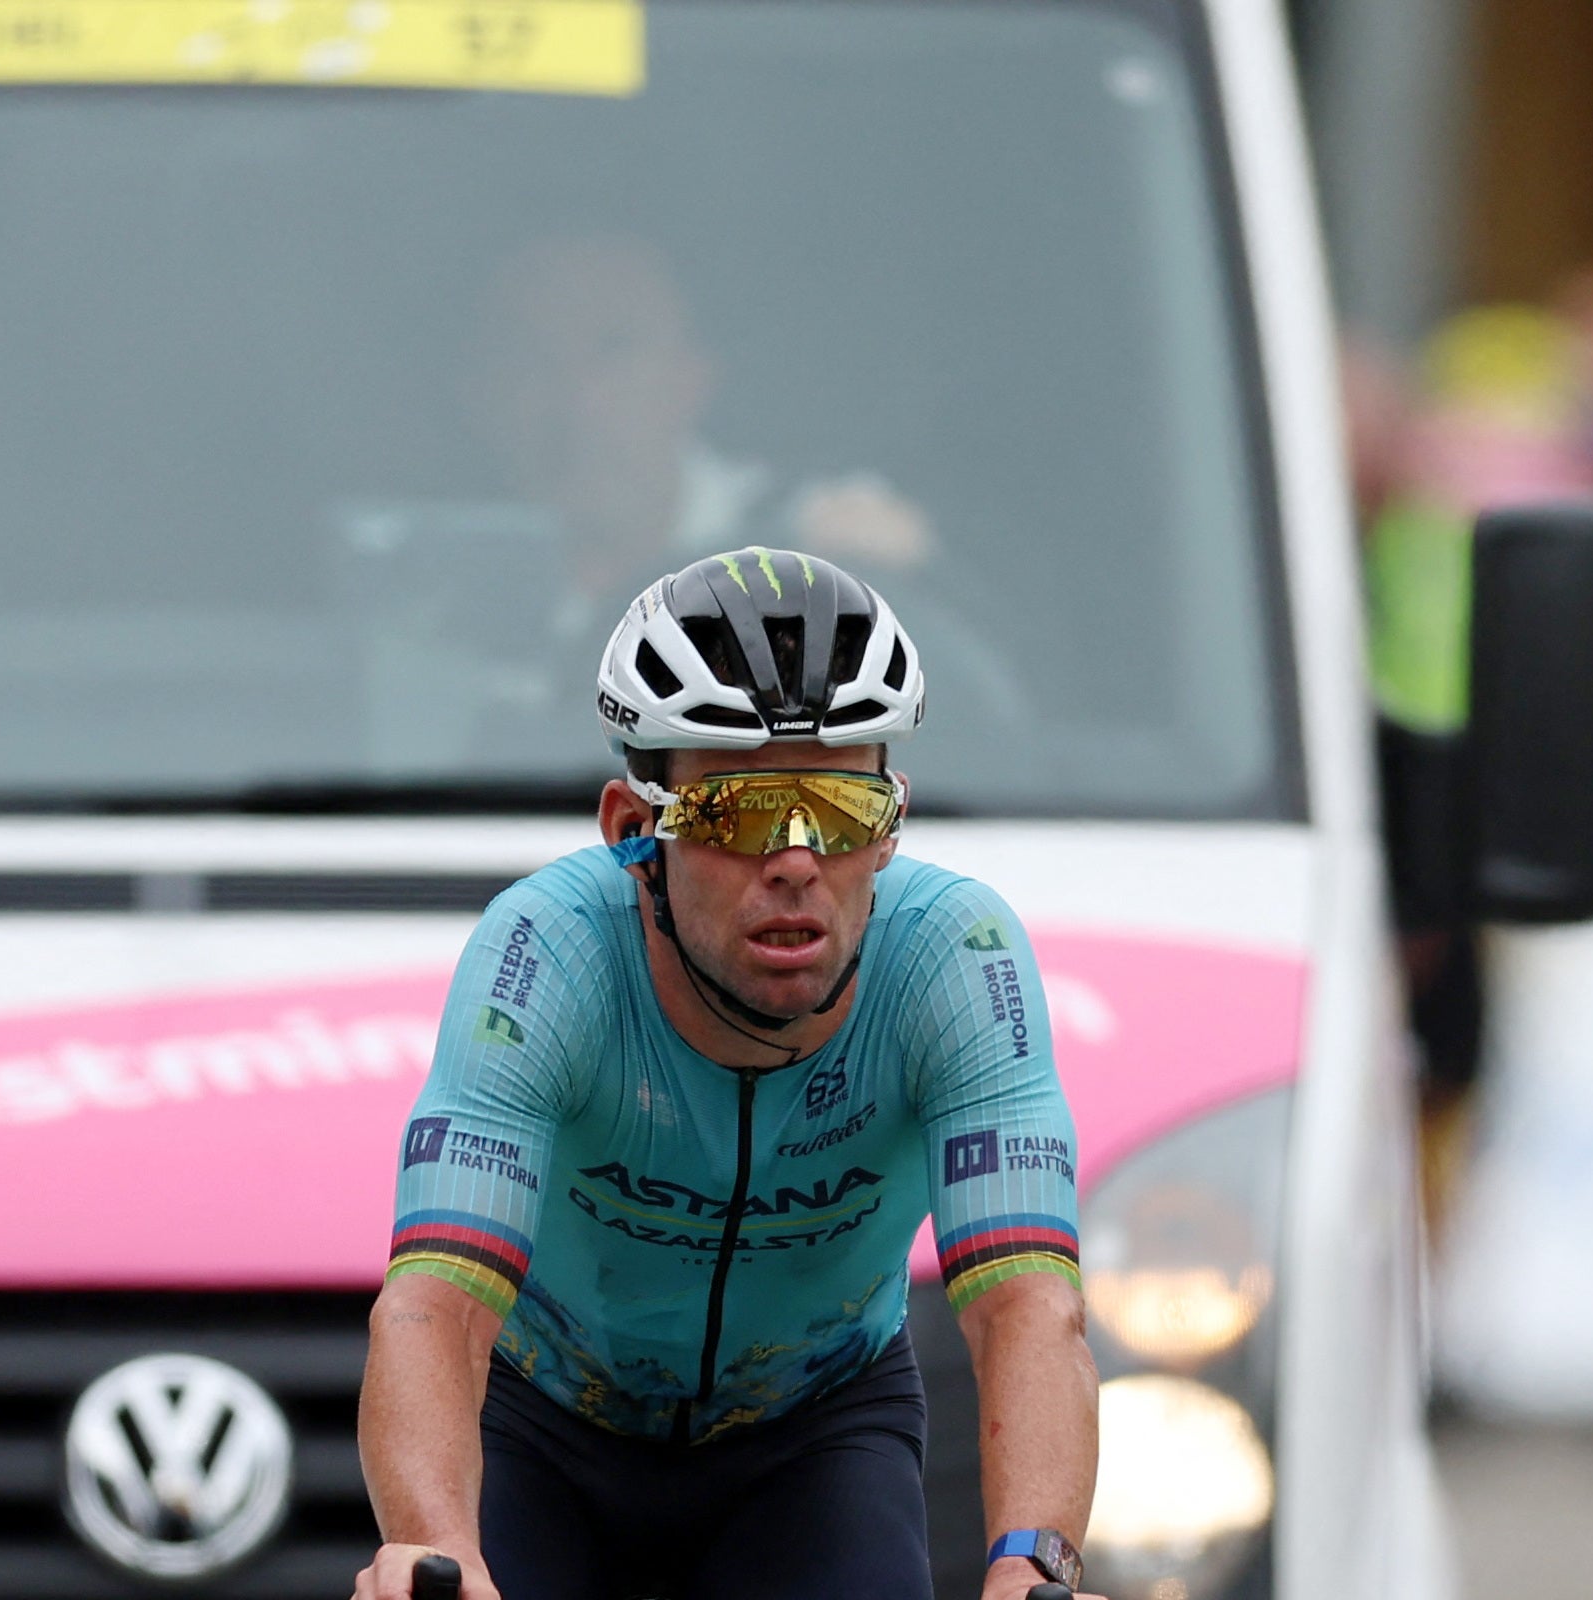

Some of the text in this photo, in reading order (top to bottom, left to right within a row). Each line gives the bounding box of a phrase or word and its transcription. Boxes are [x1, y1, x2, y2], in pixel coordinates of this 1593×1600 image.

[491, 915, 534, 1001] FREEDOM
[512, 957, 540, 1009] BROKER
[981, 962, 1006, 1024] BROKER
[998, 958, 1029, 1059] FREEDOM
[410, 1128, 434, 1154] IT
[451, 1131, 521, 1162] ITALIAN
[957, 1143, 984, 1170] IT
[1005, 1136, 1068, 1158] ITALIAN
[448, 1149, 539, 1193] TRATTORIA
[576, 1161, 886, 1219] ASTANA
[568, 1187, 882, 1251] QAZAQSTAN
